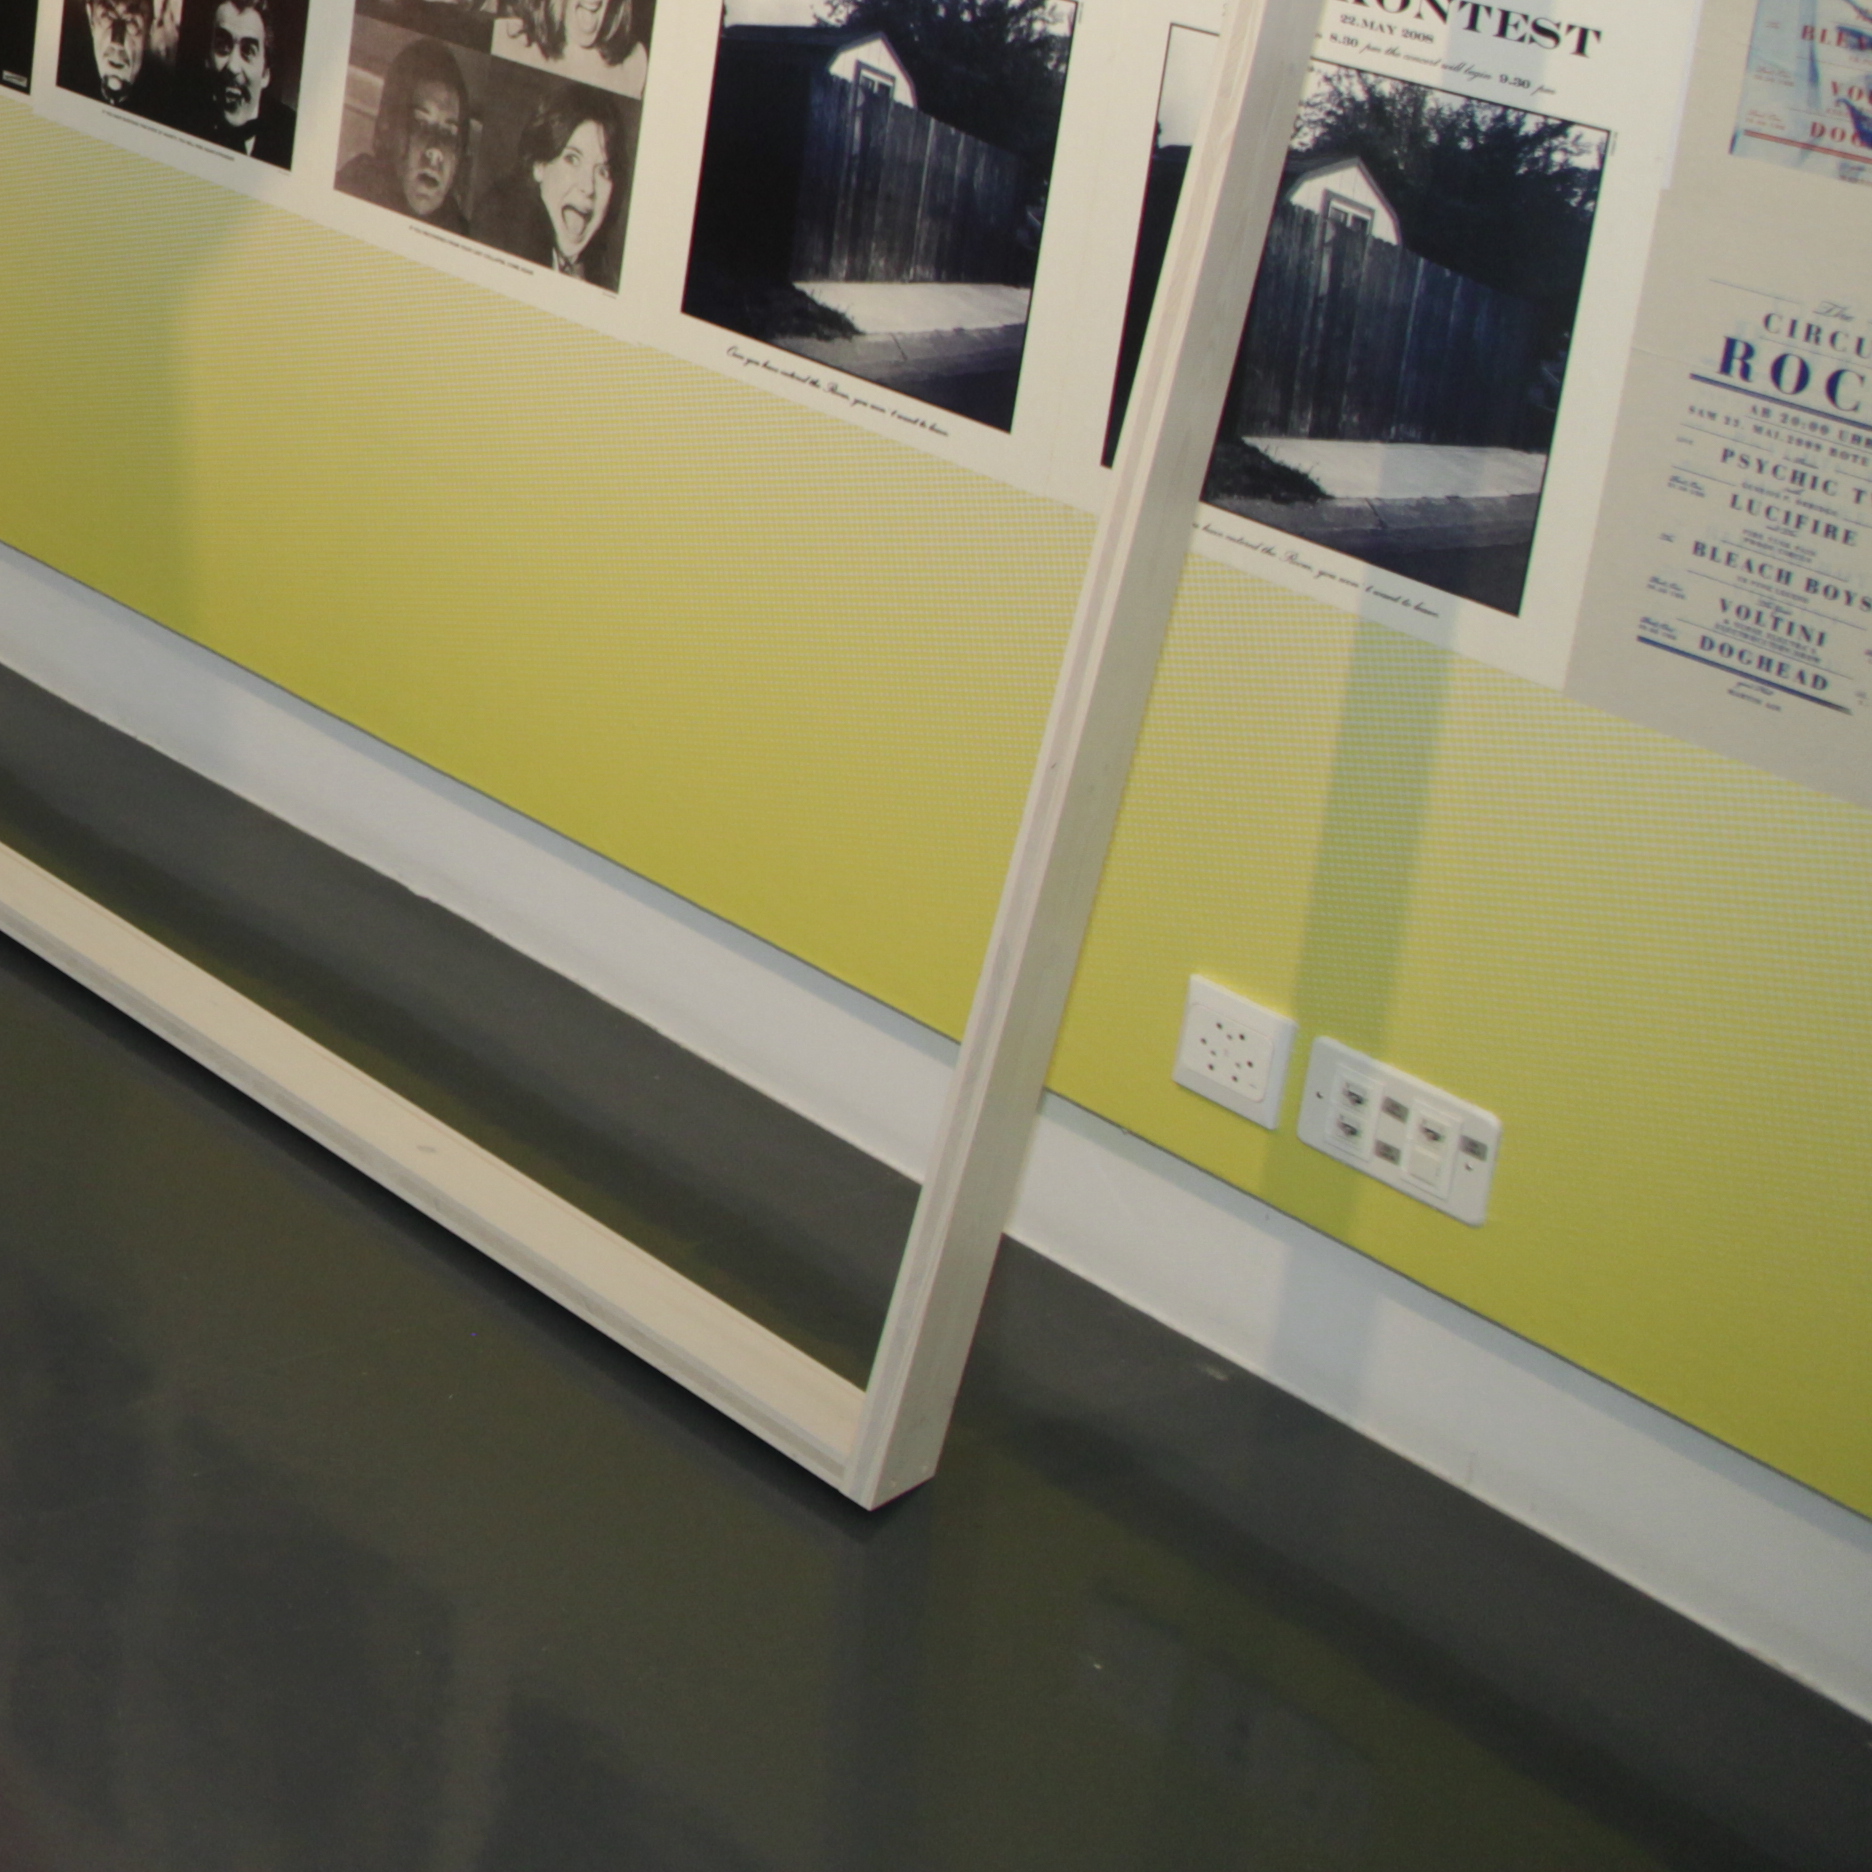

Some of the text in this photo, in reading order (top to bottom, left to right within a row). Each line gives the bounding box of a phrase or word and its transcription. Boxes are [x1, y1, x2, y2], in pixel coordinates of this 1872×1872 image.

[1401, 28, 1435, 44] 2008
[1721, 447, 1839, 497] PSYCHIC
[1730, 493, 1858, 547] LUCIFIRE
[1692, 540, 1794, 586] BLEACH
[1720, 598, 1827, 647] VOLTINI
[1699, 635, 1829, 691] DOGHEAD
